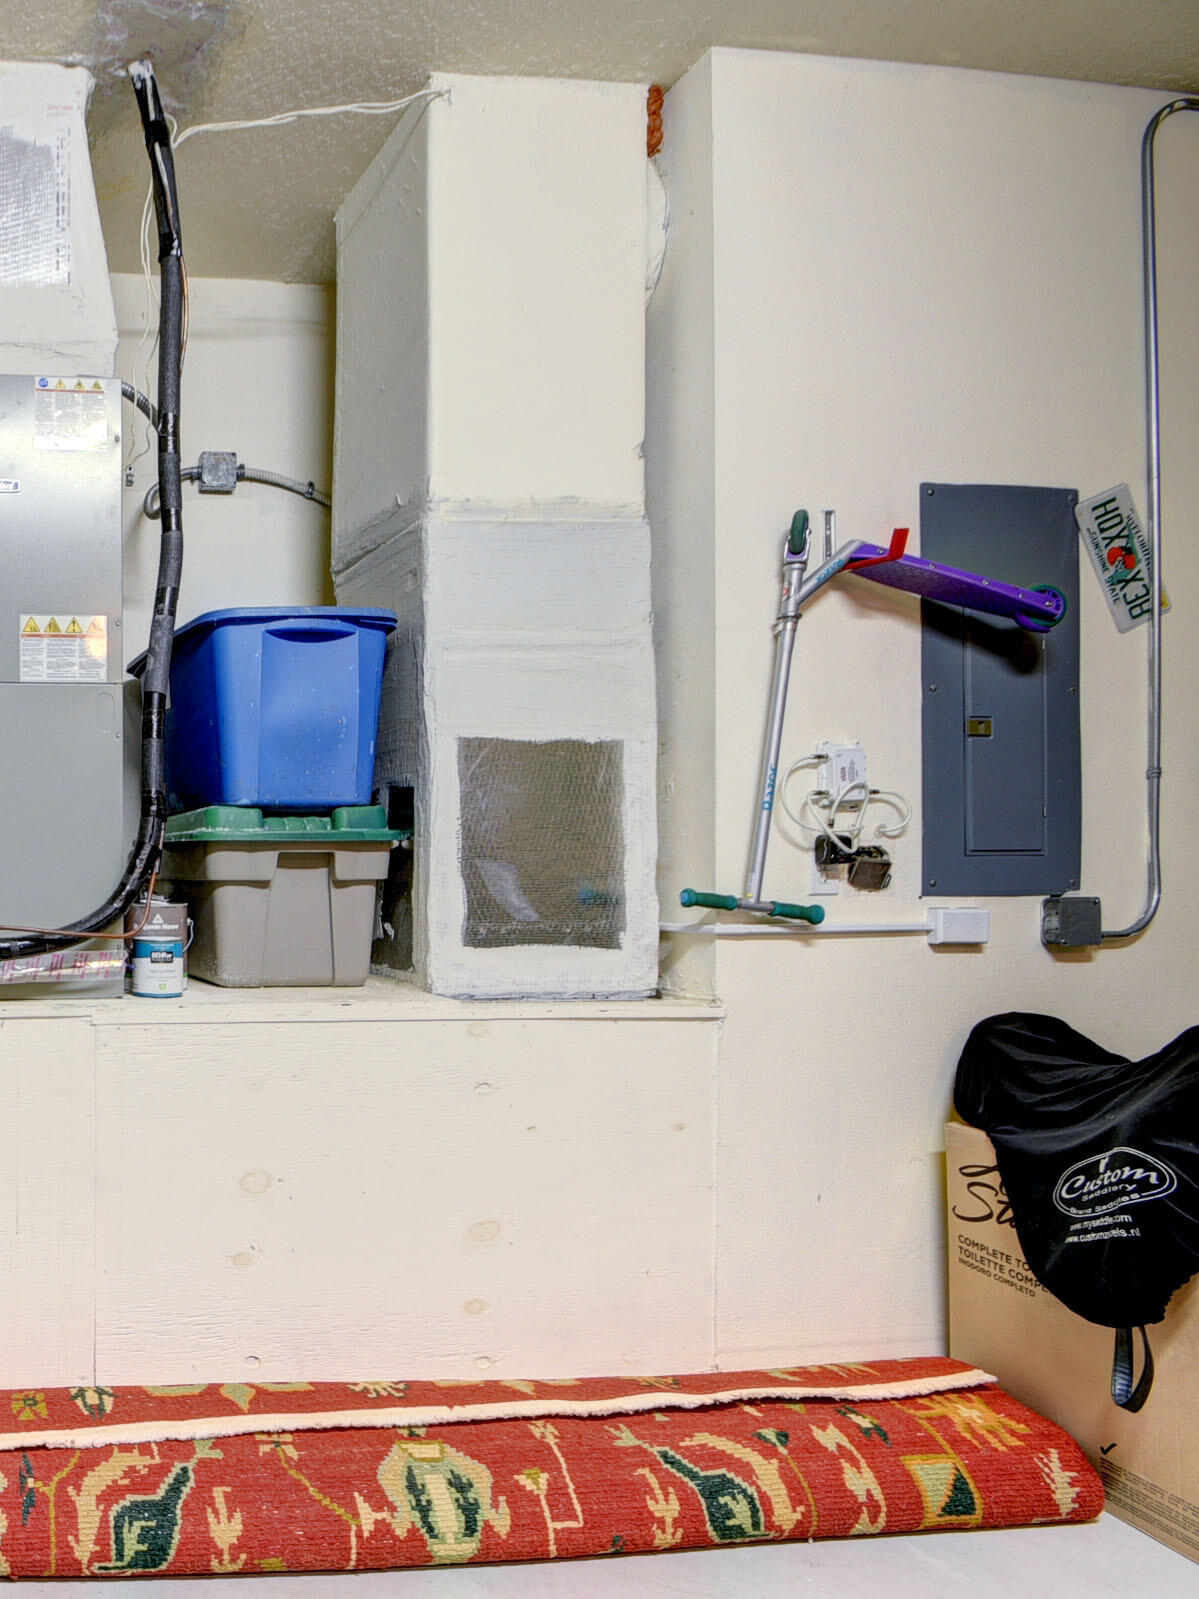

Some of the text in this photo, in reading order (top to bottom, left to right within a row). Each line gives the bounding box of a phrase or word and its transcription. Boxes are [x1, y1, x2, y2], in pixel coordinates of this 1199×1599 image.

[1088, 530, 1111, 573] SUNSHINE
[1061, 1156, 1159, 1199] Custom
[957, 1233, 1013, 1265] COMPLETE
[957, 1244, 1006, 1275] TOILETTE
[957, 1256, 1037, 1298] INODORO COMPLETO
